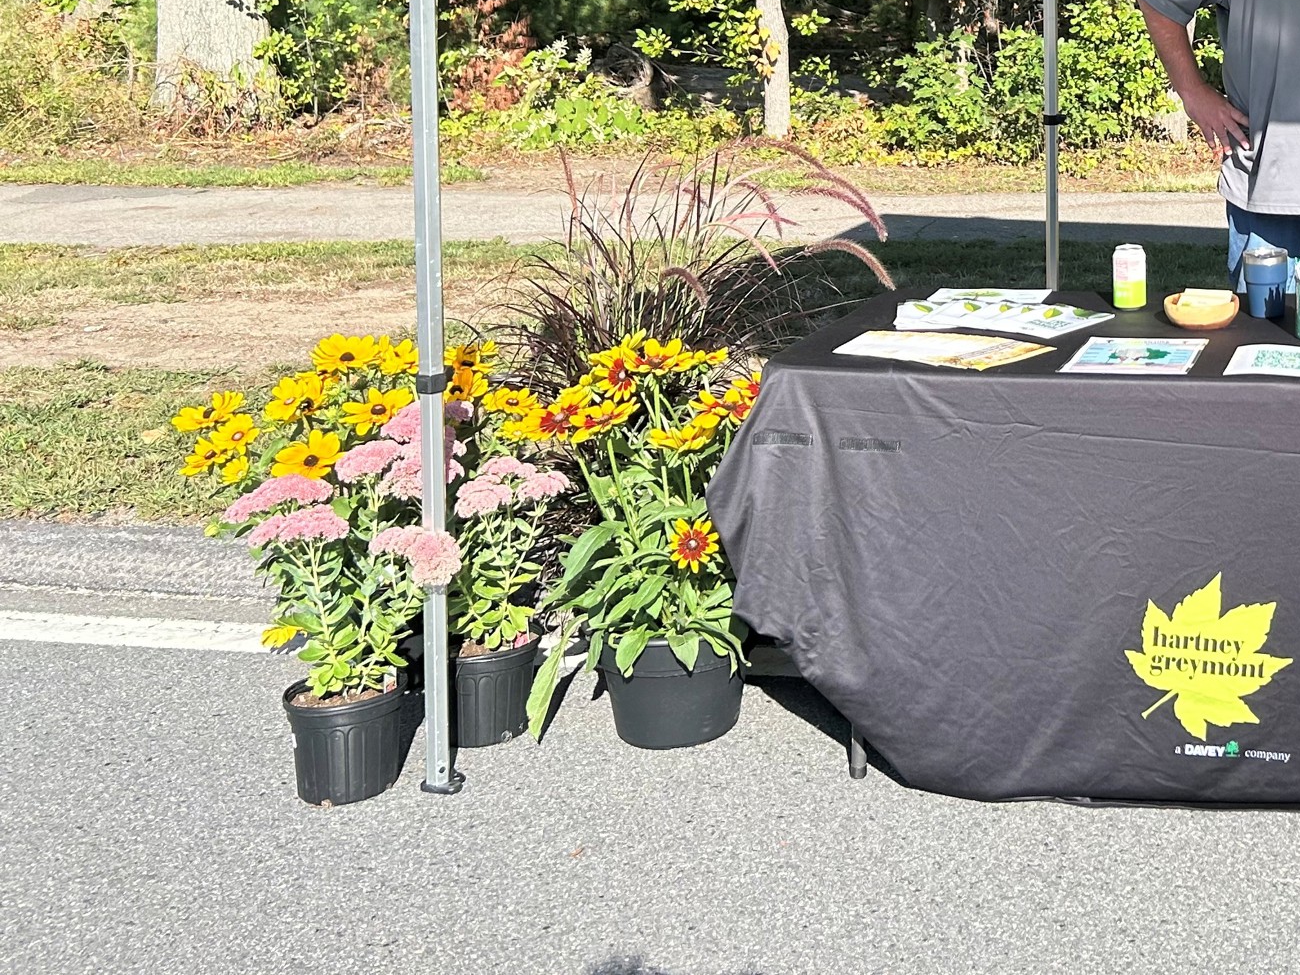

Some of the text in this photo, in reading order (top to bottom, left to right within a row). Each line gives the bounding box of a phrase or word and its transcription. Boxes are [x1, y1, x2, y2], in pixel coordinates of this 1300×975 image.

[1152, 625, 1245, 661] hartney
[1149, 653, 1266, 680] greymont
[1174, 743, 1291, 763] a DAVEY company
